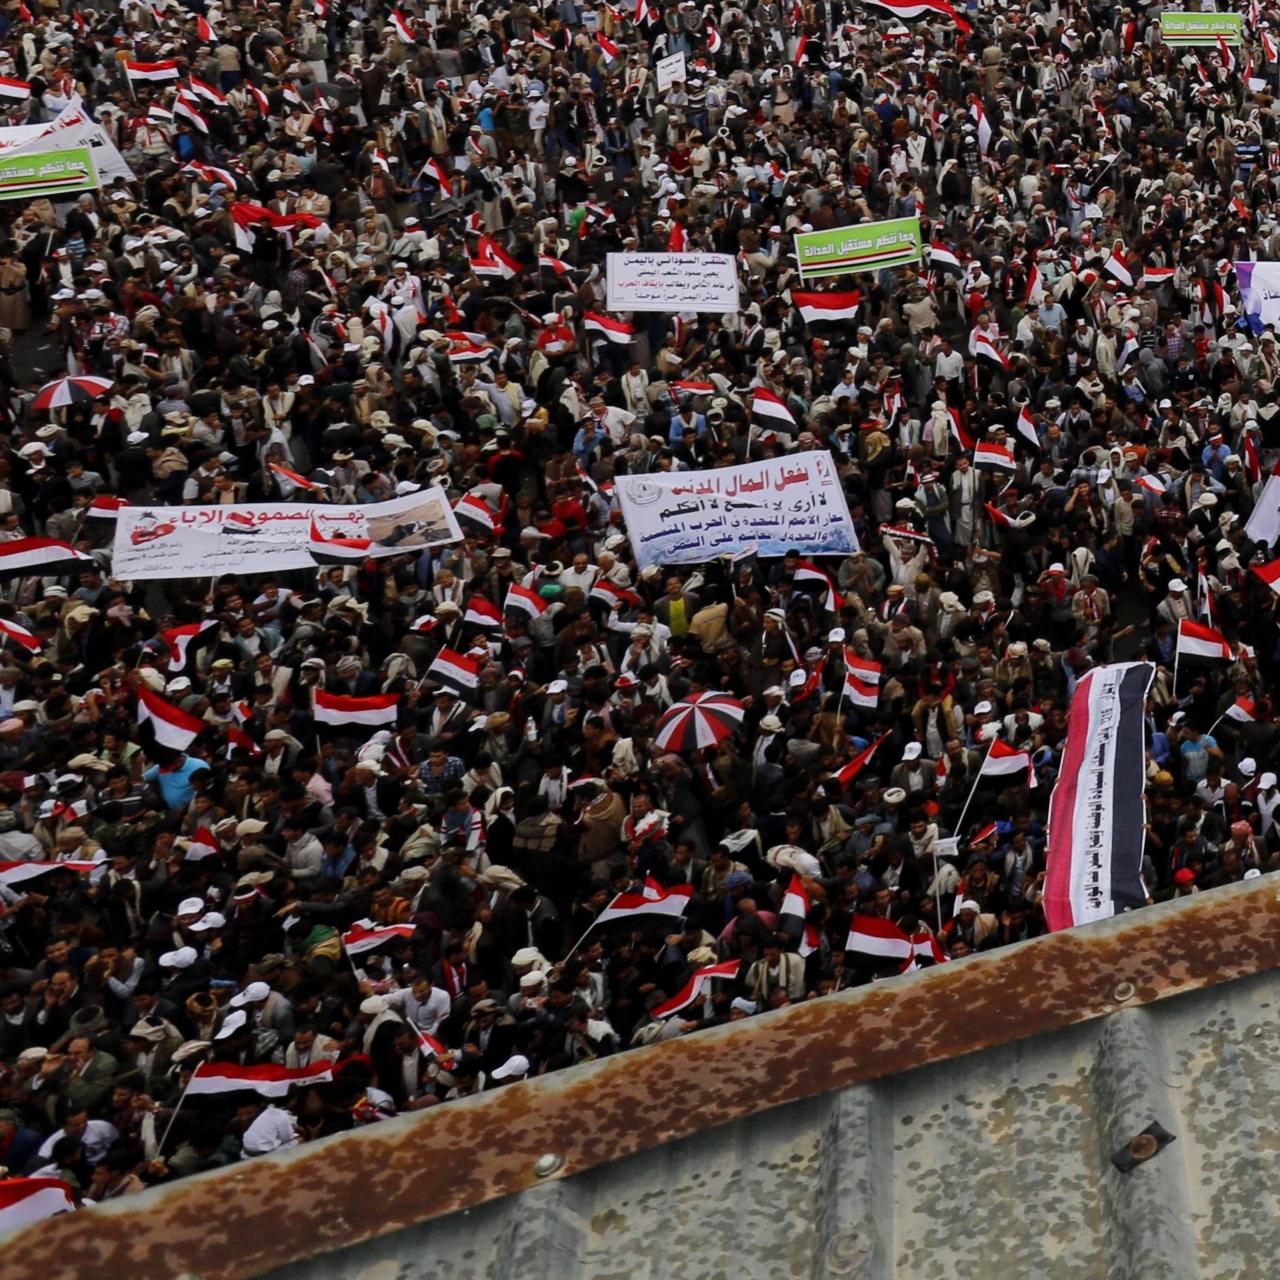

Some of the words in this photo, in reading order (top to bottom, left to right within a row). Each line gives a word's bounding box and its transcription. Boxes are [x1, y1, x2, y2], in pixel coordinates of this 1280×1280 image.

[804, 244, 834, 257] العدالة
[837, 239, 873, 255] مستقبل
[624, 256, 655, 267] باليمن
[725, 468, 770, 497] المال
[774, 462, 810, 492] بفعل
[788, 490, 817, 513] أرى
[689, 515, 728, 532] الحرب
[743, 514, 785, 527] المتحدة
[709, 532, 734, 548] على
